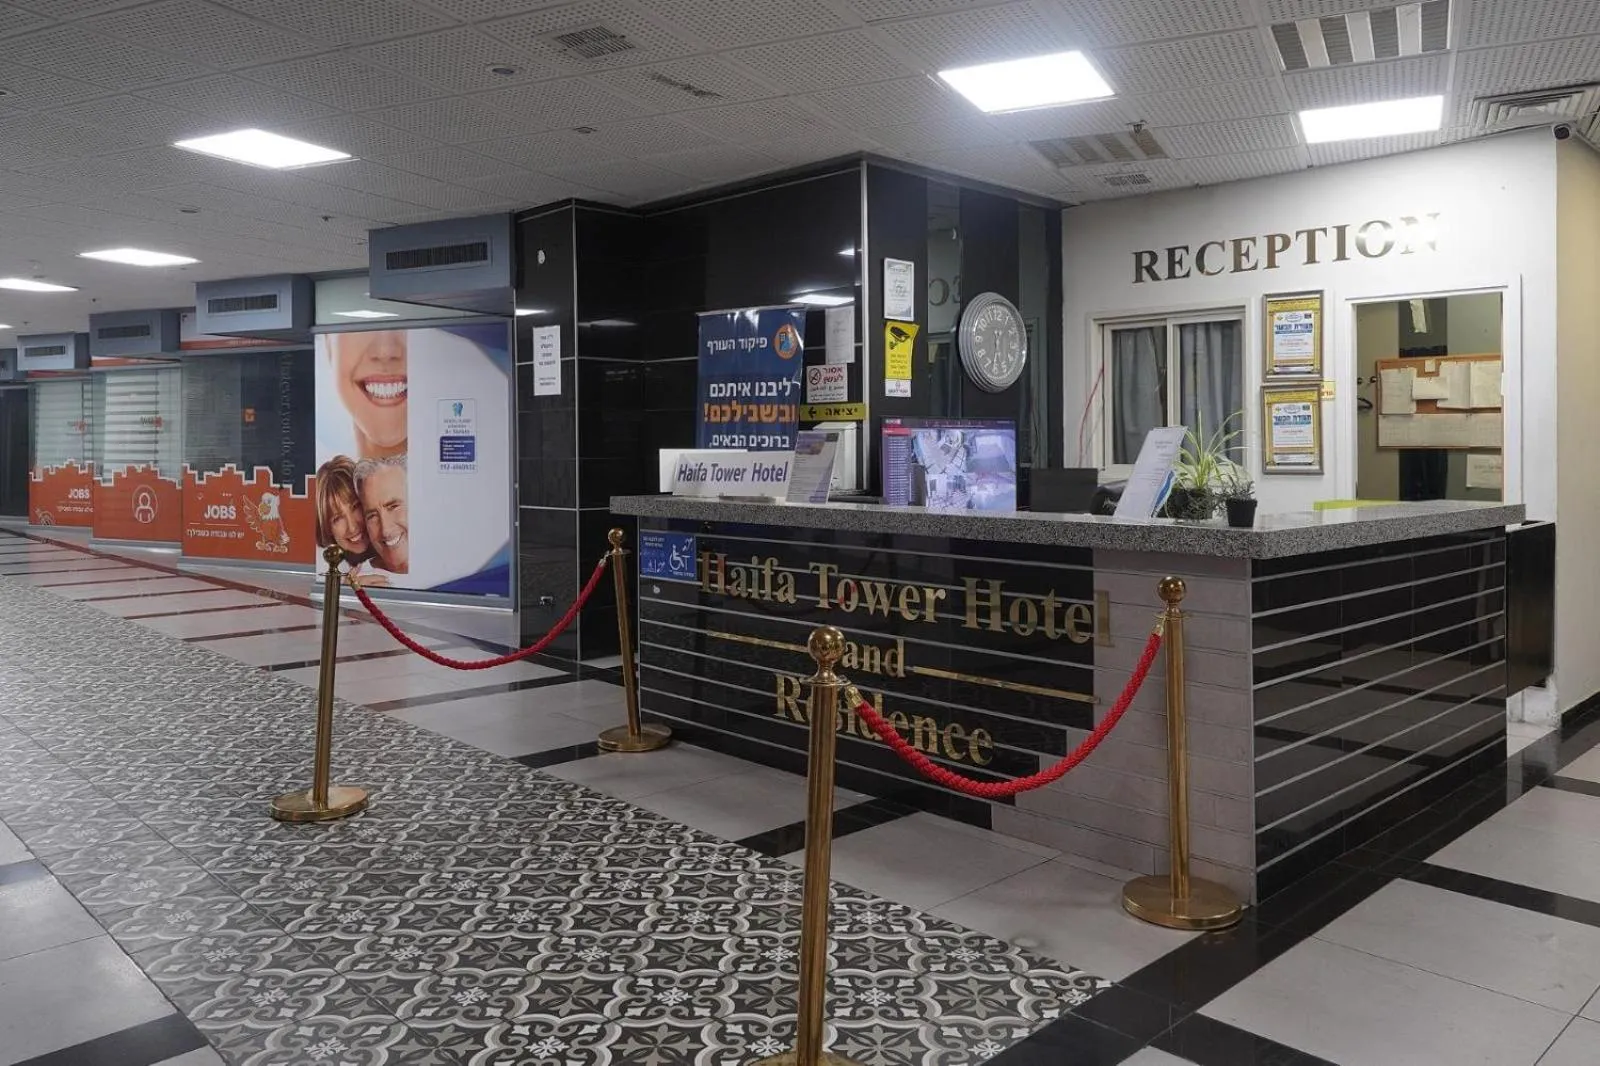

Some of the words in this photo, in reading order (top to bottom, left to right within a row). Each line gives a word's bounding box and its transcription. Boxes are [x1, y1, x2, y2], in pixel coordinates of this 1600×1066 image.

[1131, 213, 1440, 284] RECEPTION
[706, 339, 736, 355] העורף
[738, 337, 768, 352] פיקוד
[822, 366, 844, 374] אסור
[709, 382, 752, 398] איתכם
[754, 377, 792, 397] ליבנו
[703, 400, 796, 423] ובשבילכם!
[825, 407, 858, 417] יציאה
[749, 434, 790, 448] ברוכים
[677, 462, 708, 482] Haifa
[710, 463, 748, 482] Tower
[751, 461, 788, 483] Hotel
[68, 488, 90, 499] JOBS
[204, 504, 237, 519] JOBS
[700, 551, 797, 605] Haifa
[809, 562, 946, 628] Tower
[960, 576, 1115, 648] Hotel
[841, 638, 906, 678] and
[774, 672, 994, 766] Ridence
